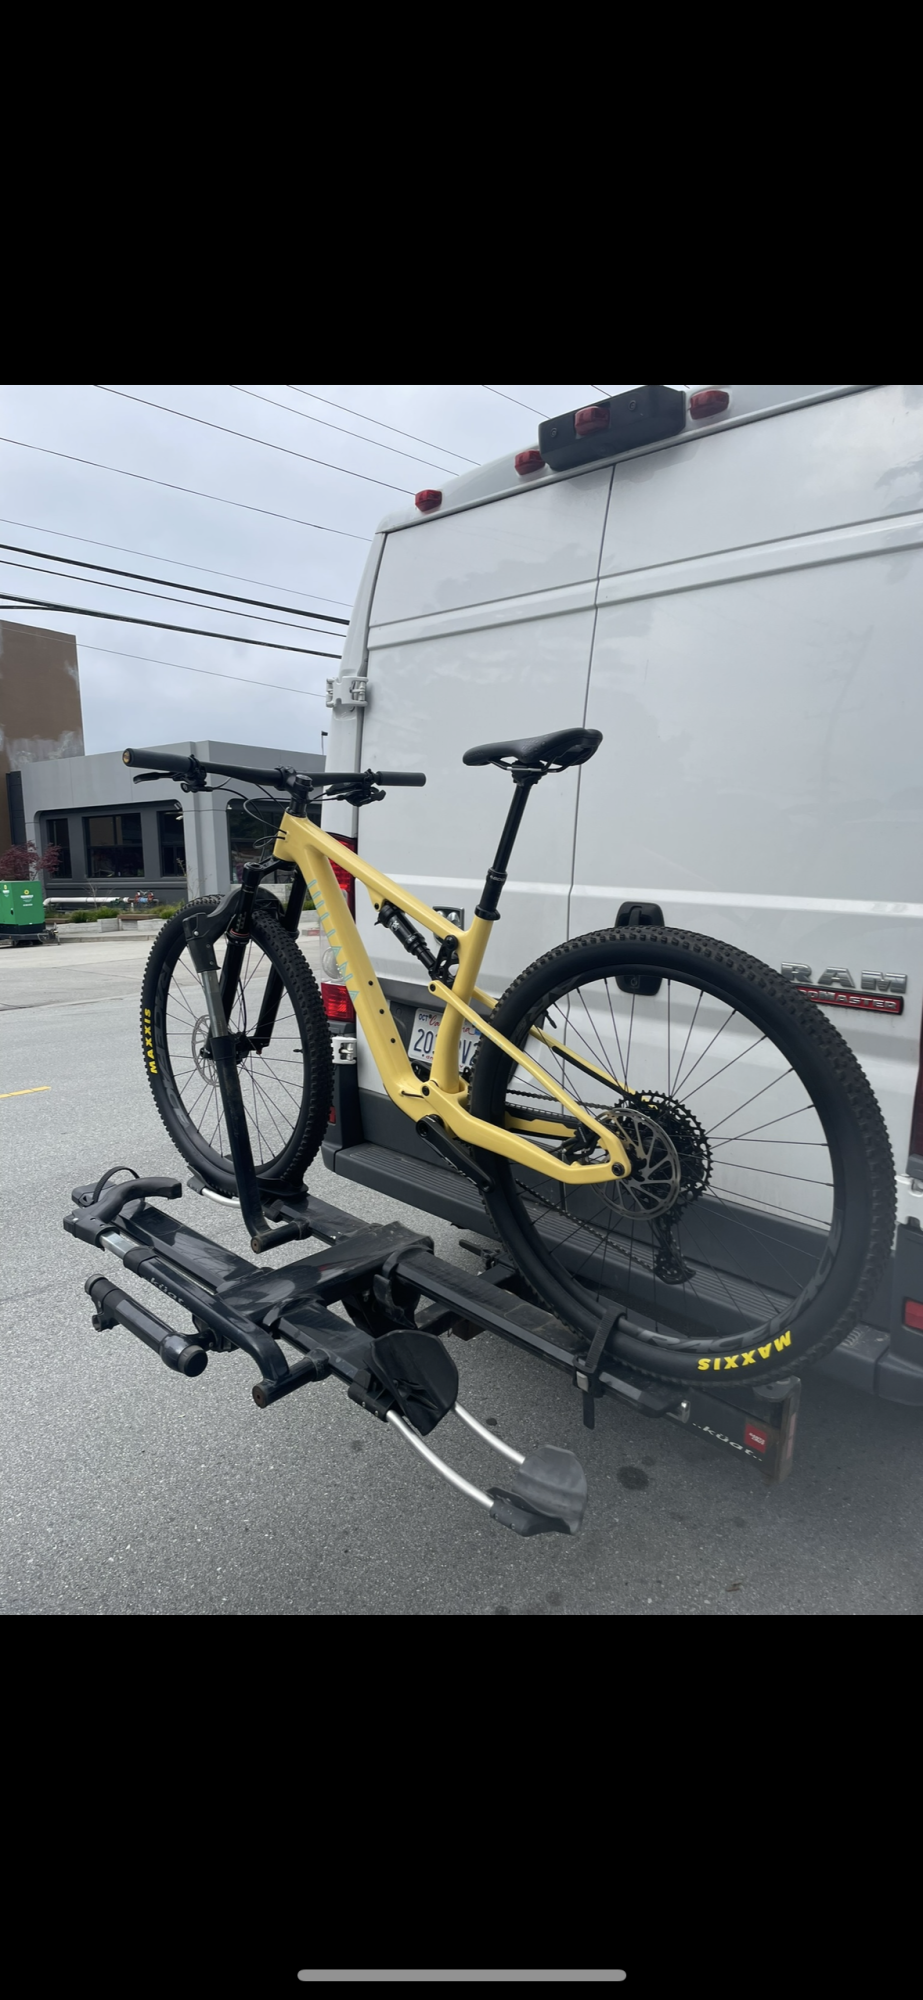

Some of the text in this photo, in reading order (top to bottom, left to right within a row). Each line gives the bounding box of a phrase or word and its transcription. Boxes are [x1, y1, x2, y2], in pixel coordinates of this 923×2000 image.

[781, 962, 907, 994] RAM
[799, 989, 897, 1010] OMASTER
[144, 1008, 158, 1074] MAXXIS
[697, 1330, 792, 1371] MAXXIS
